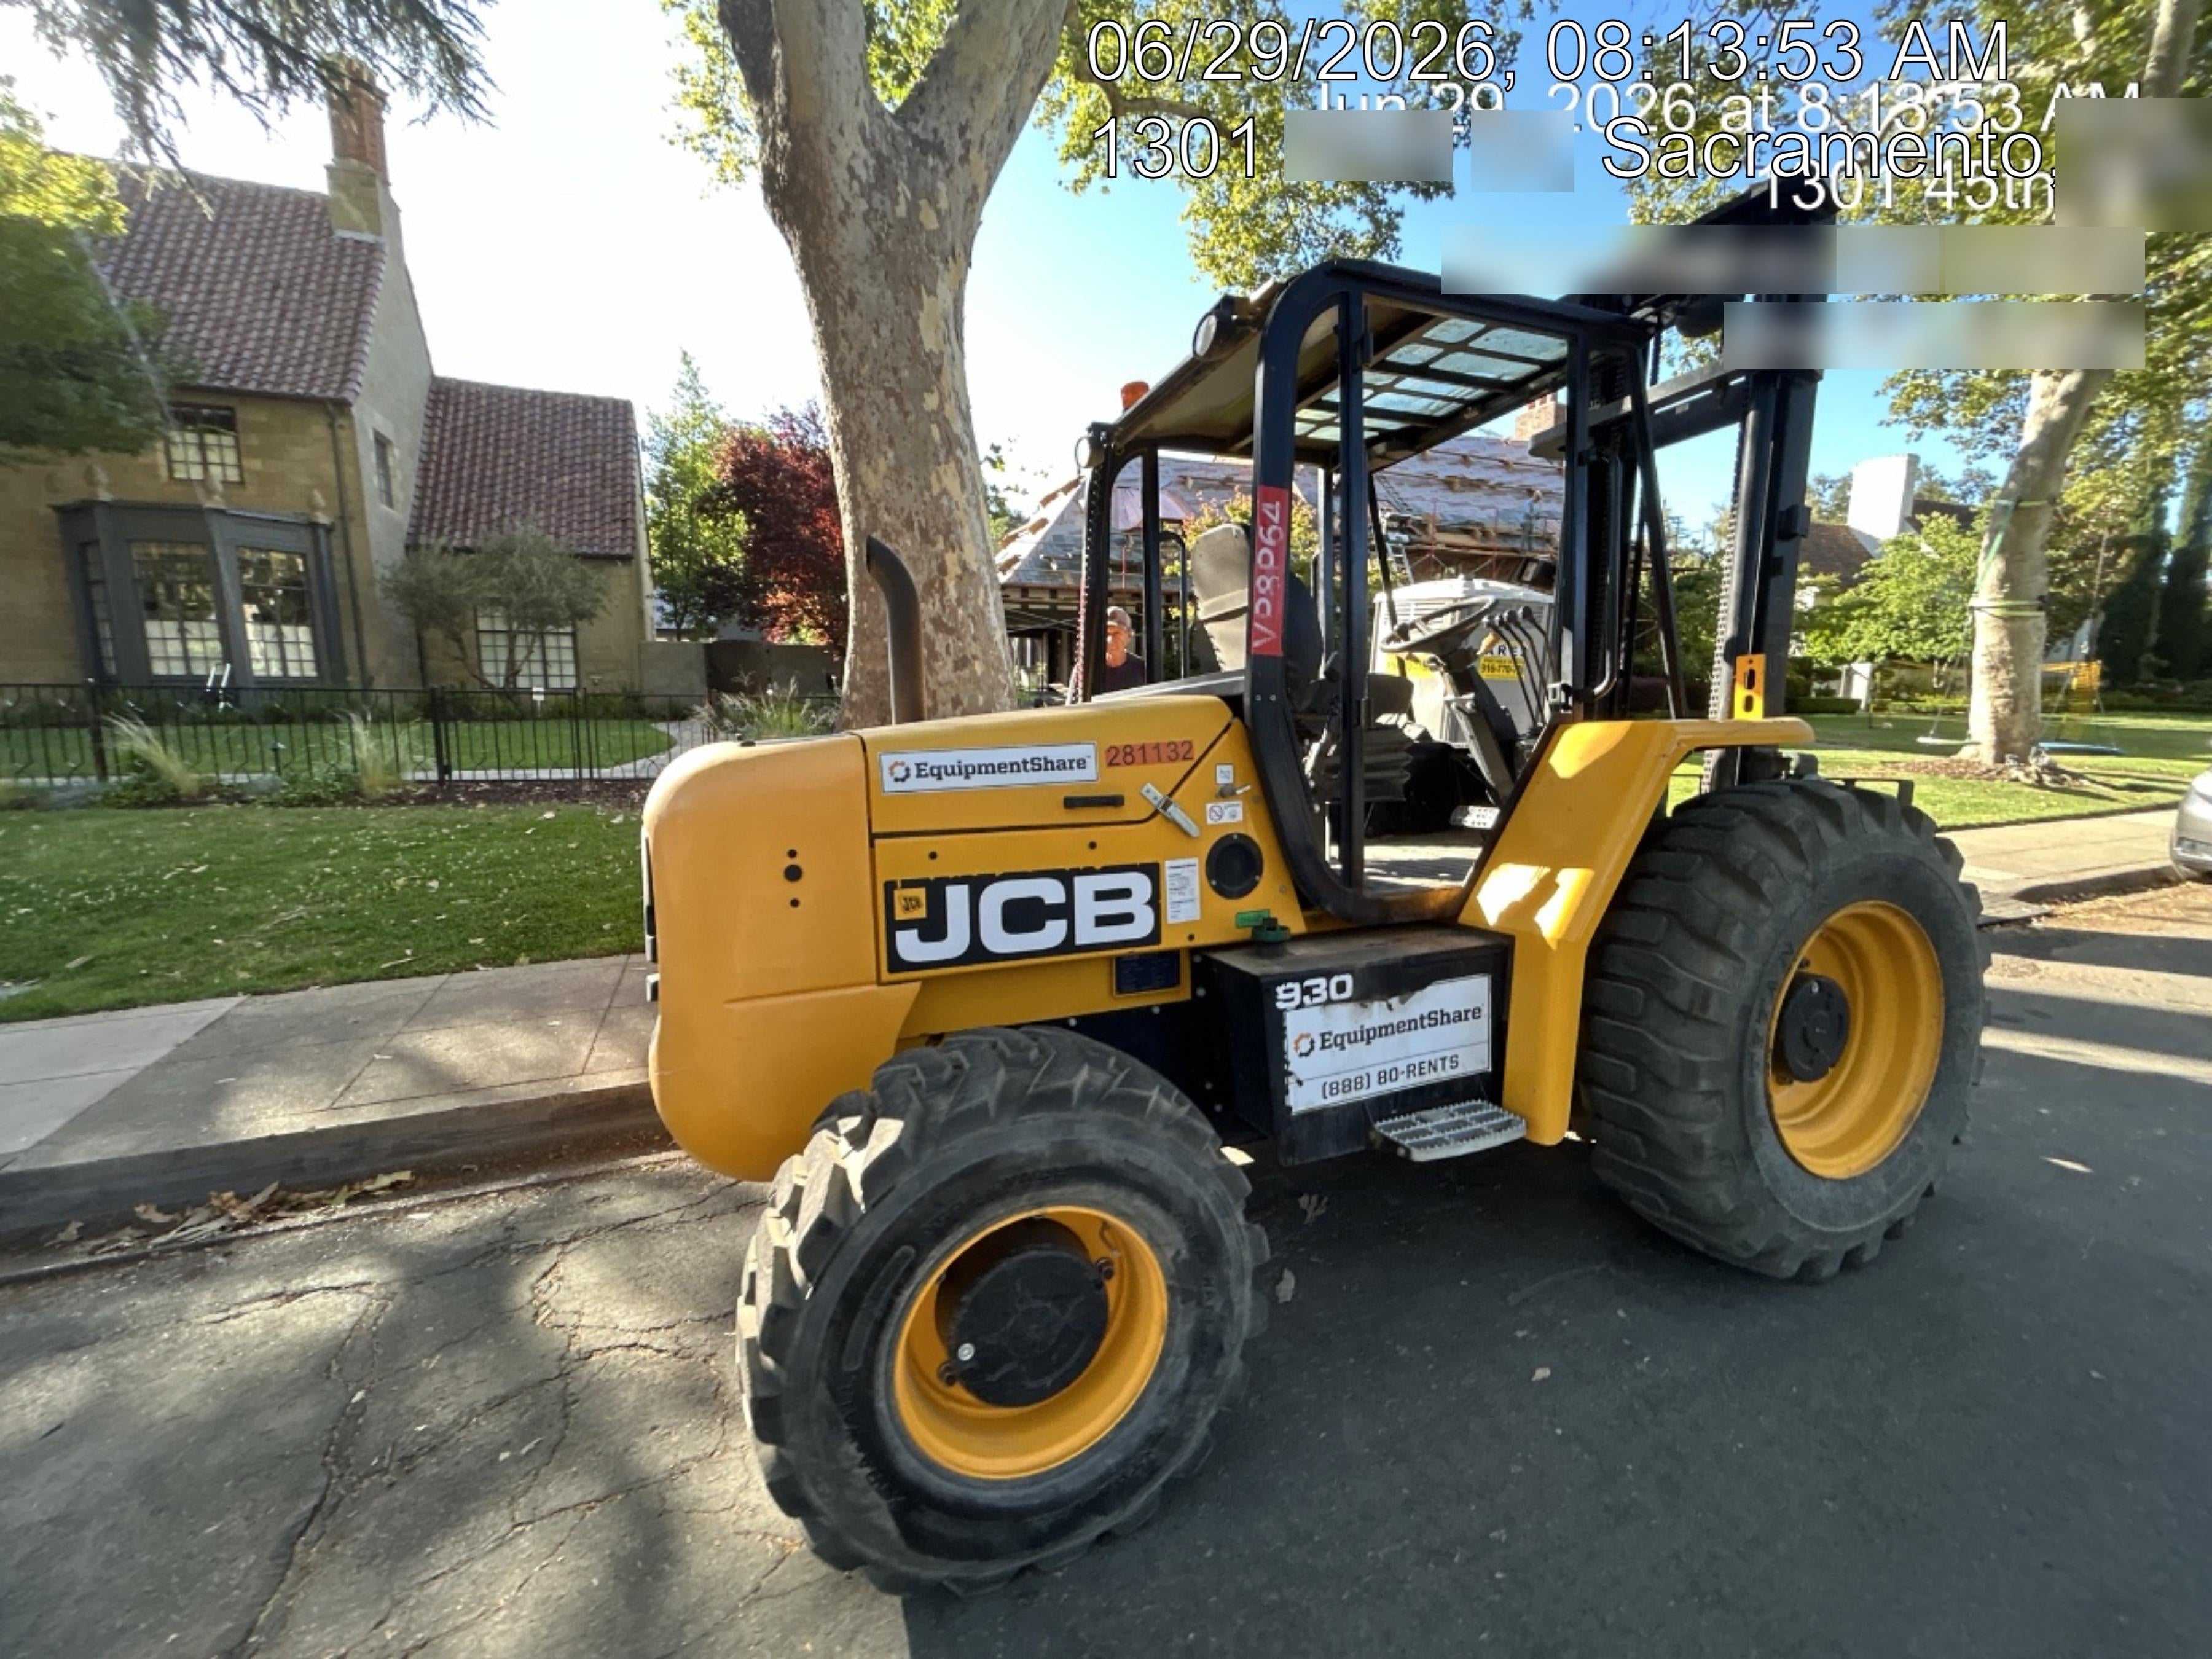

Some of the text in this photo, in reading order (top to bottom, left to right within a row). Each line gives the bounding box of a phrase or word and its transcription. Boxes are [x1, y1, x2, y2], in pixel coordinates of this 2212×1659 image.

[914, 755, 1088, 780] EquipmentShare
[1107, 740, 1194, 767] 281132
[894, 871, 1155, 963] JCB
[1275, 973, 1354, 1010] 930
[1319, 1006, 1483, 1051] EquipmentShare
[1321, 1054, 1460, 1099] (888) 80-RENTS
